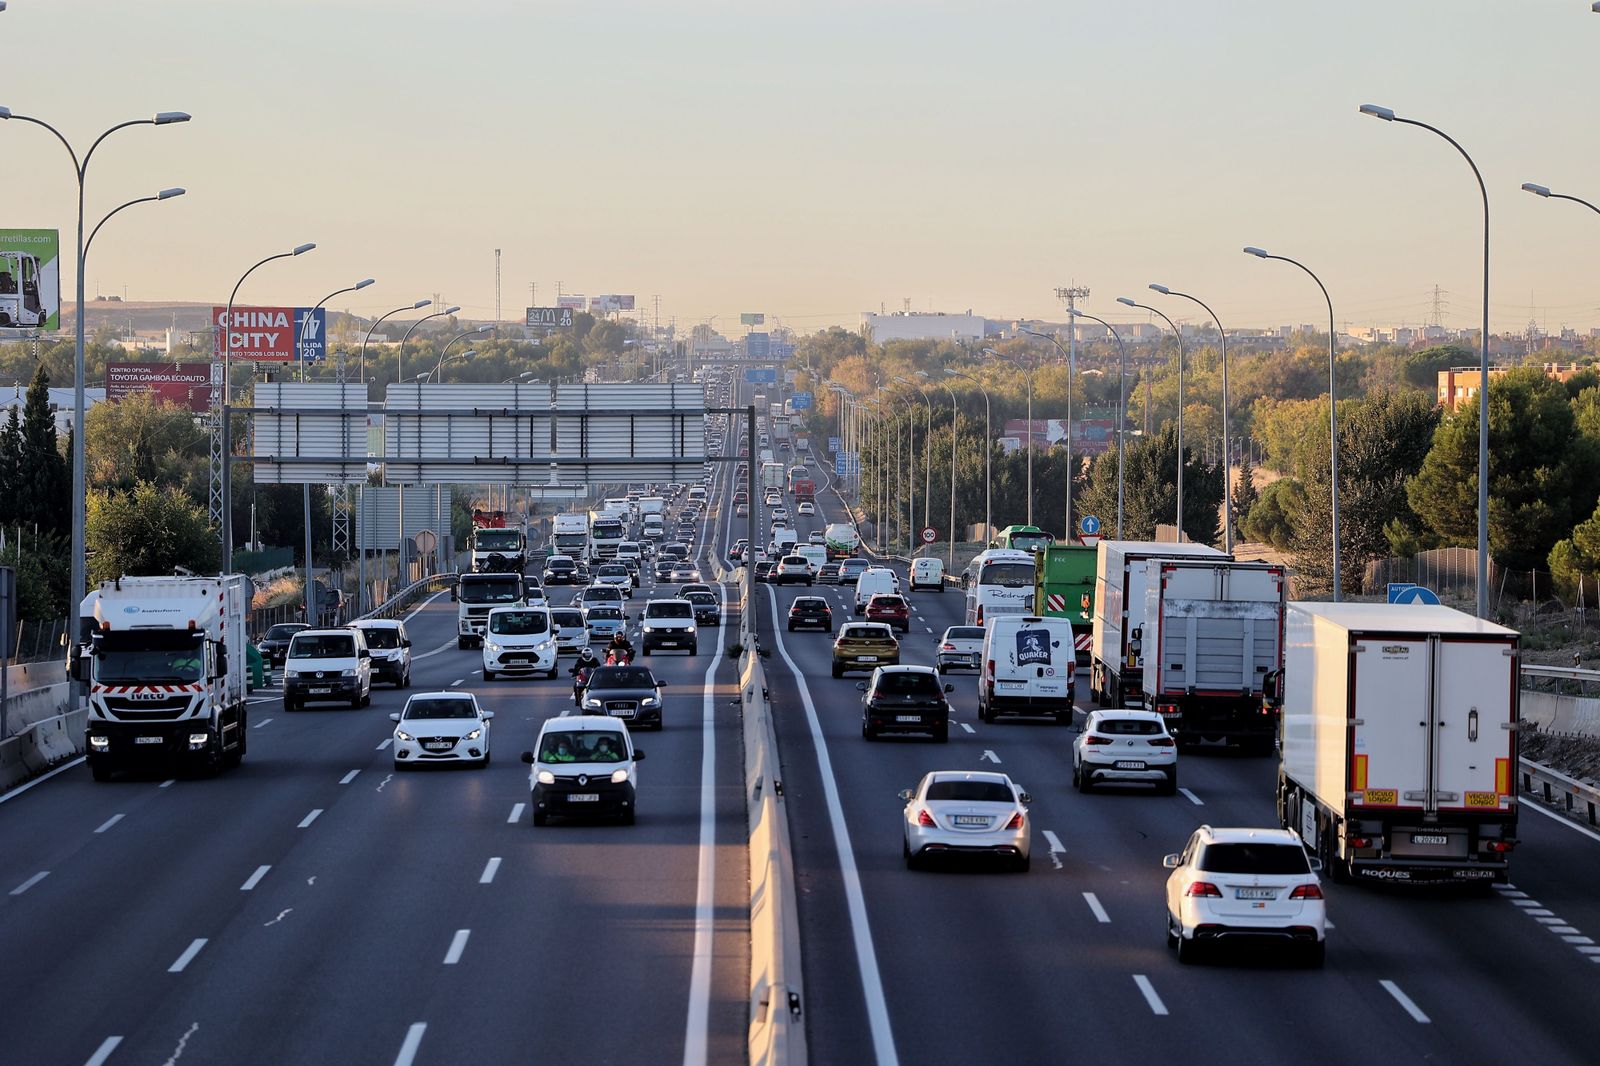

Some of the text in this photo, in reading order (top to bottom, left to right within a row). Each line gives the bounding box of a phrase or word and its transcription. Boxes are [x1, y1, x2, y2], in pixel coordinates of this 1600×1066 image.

[218, 311, 289, 328] CHINA
[560, 318, 572, 326] 20
[229, 332, 280, 348] CITY
[303, 348, 315, 357] 20
[139, 374, 171, 382] GAMBOA
[923, 531, 935, 539] 100
[1382, 645, 1409, 653] CHEREAU
[1018, 651, 1049, 661] QUAKER
[131, 692, 165, 700] IVECO
[1366, 789, 1394, 797] VEICULO
[1468, 792, 1496, 800] VEICULO
[1361, 868, 1410, 879] ROQUES
[1454, 870, 1496, 878] CHEREAU
